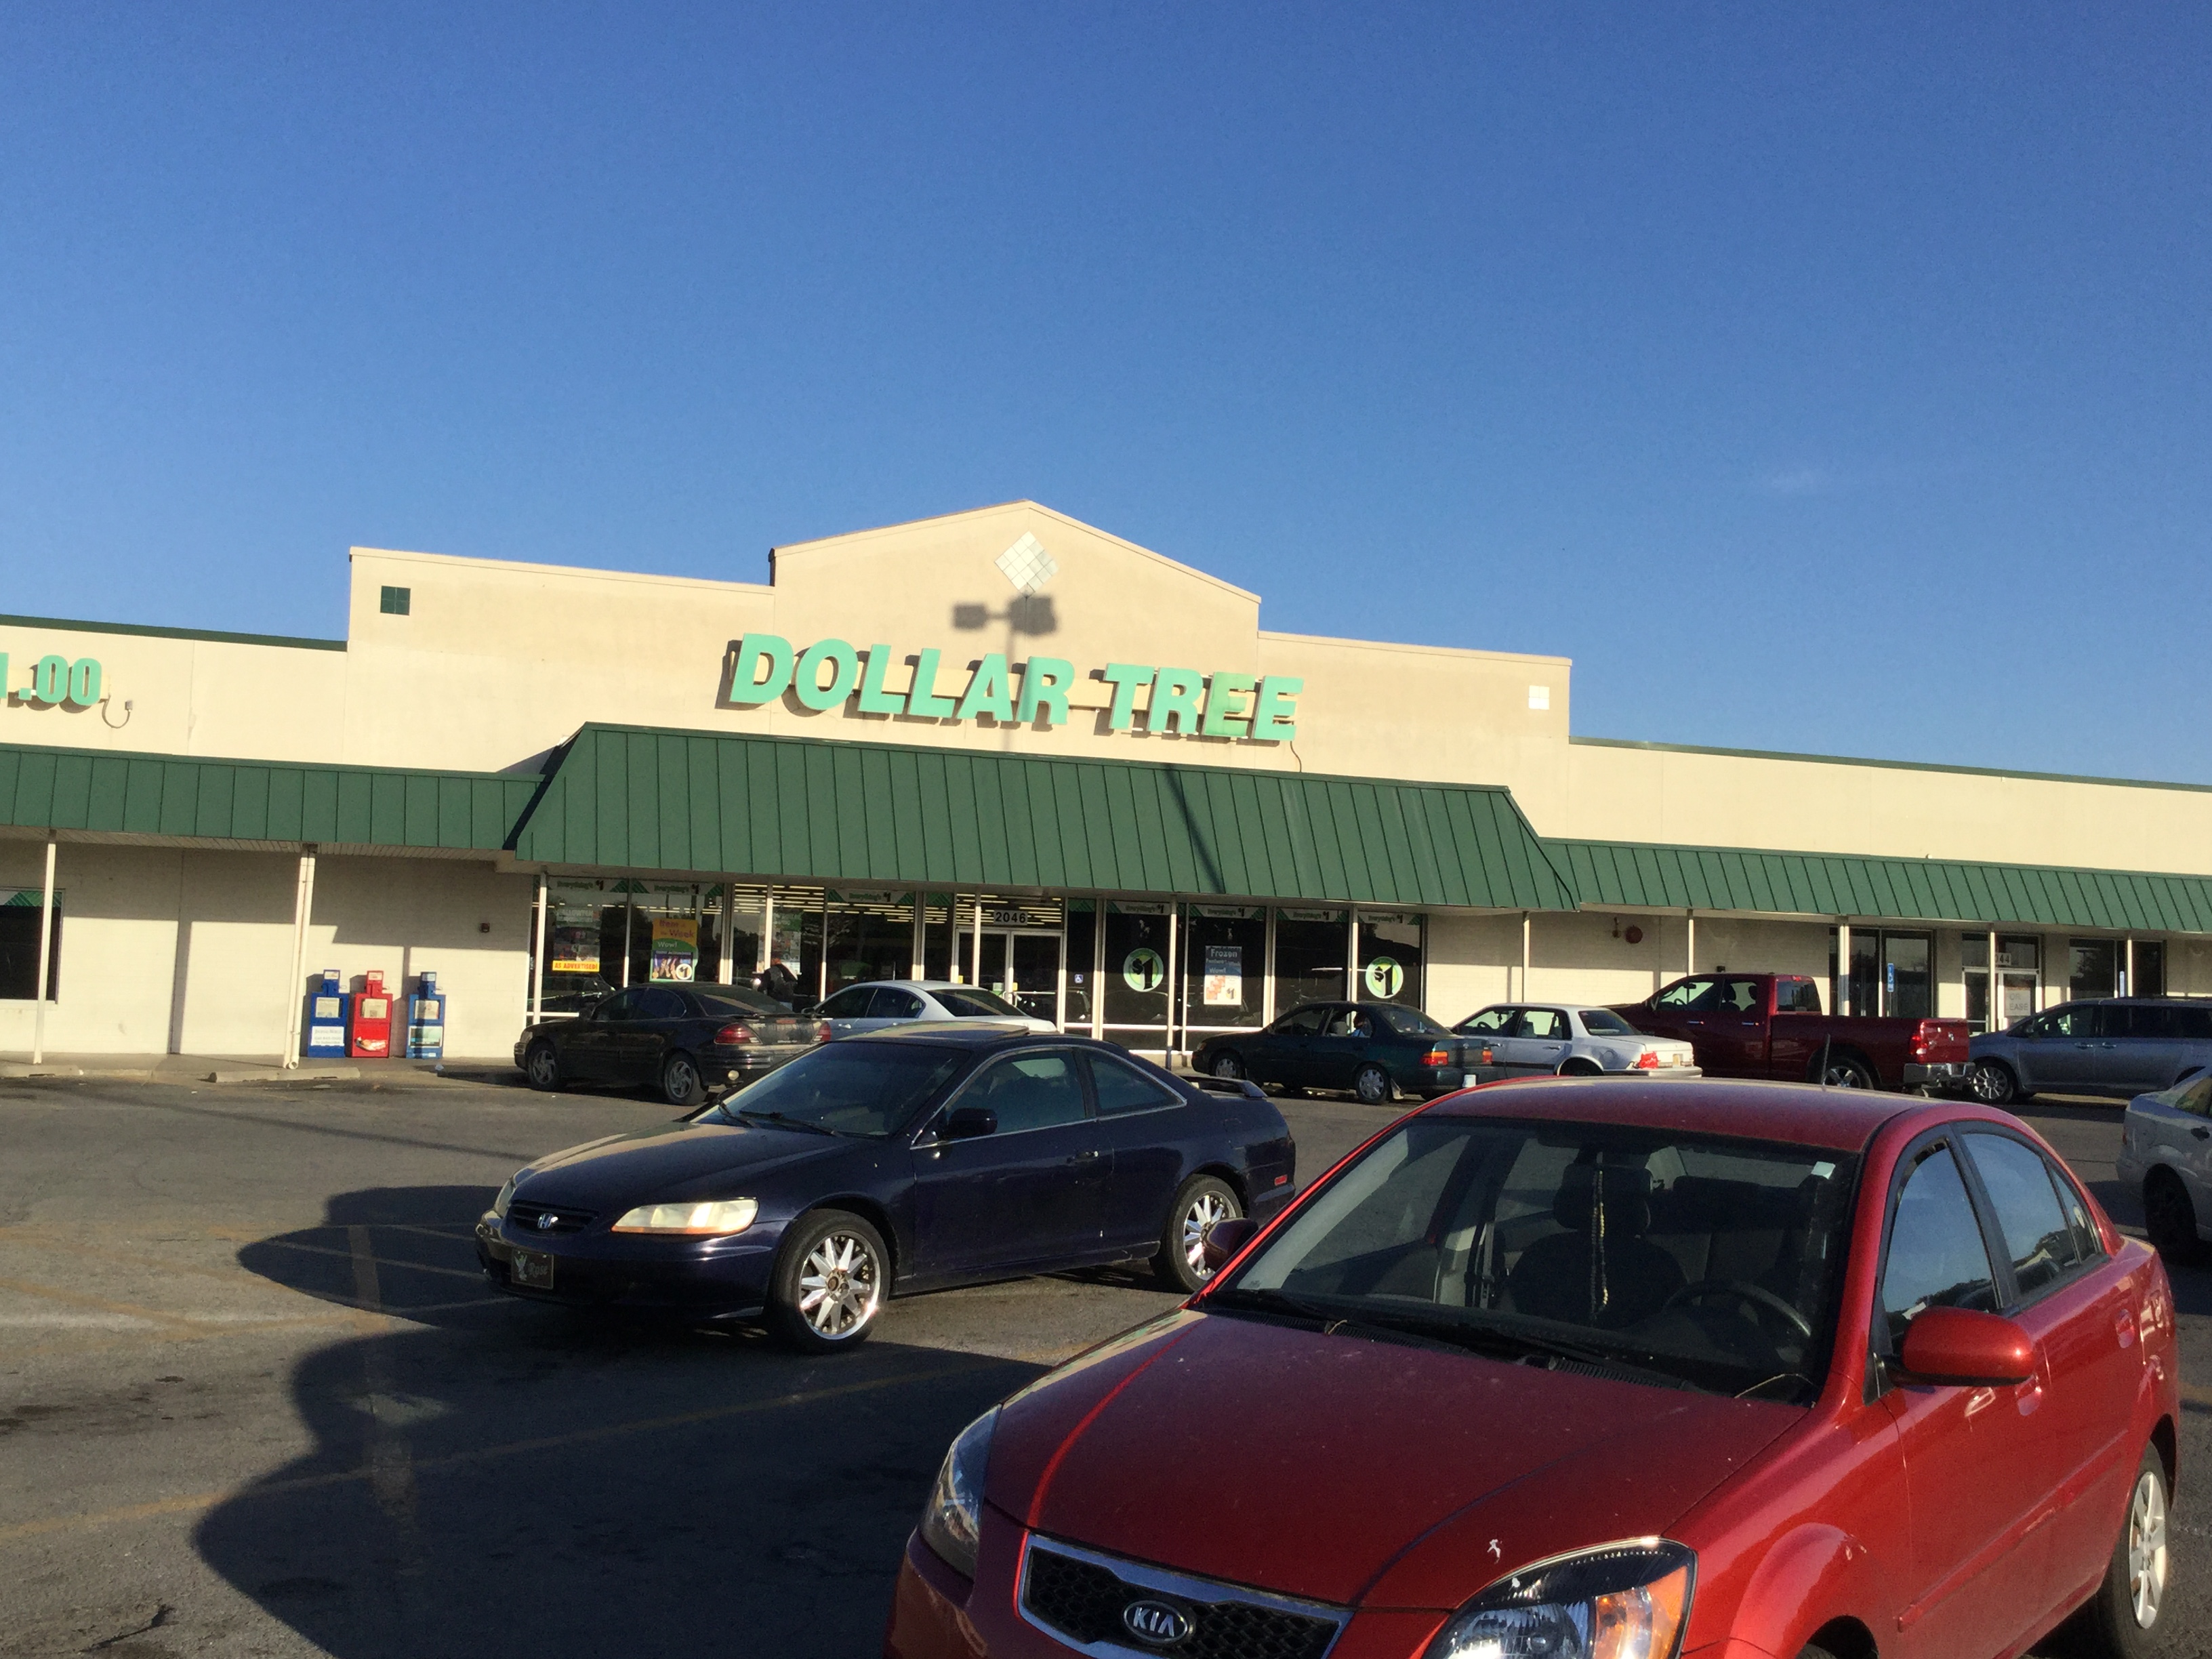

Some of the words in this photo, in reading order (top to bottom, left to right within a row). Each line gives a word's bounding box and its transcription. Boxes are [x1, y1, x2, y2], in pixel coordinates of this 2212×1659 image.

[729, 633, 1075, 725] DOLLAR
[1104, 662, 1304, 741] TREE
[995, 912, 1026, 923] 2046
[1210, 949, 1237, 958] Frozen
[679, 966, 689, 978] $1
[1132, 956, 1153, 990] $1
[1374, 964, 1393, 997] $1
[1132, 1606, 1176, 1638] KIA
